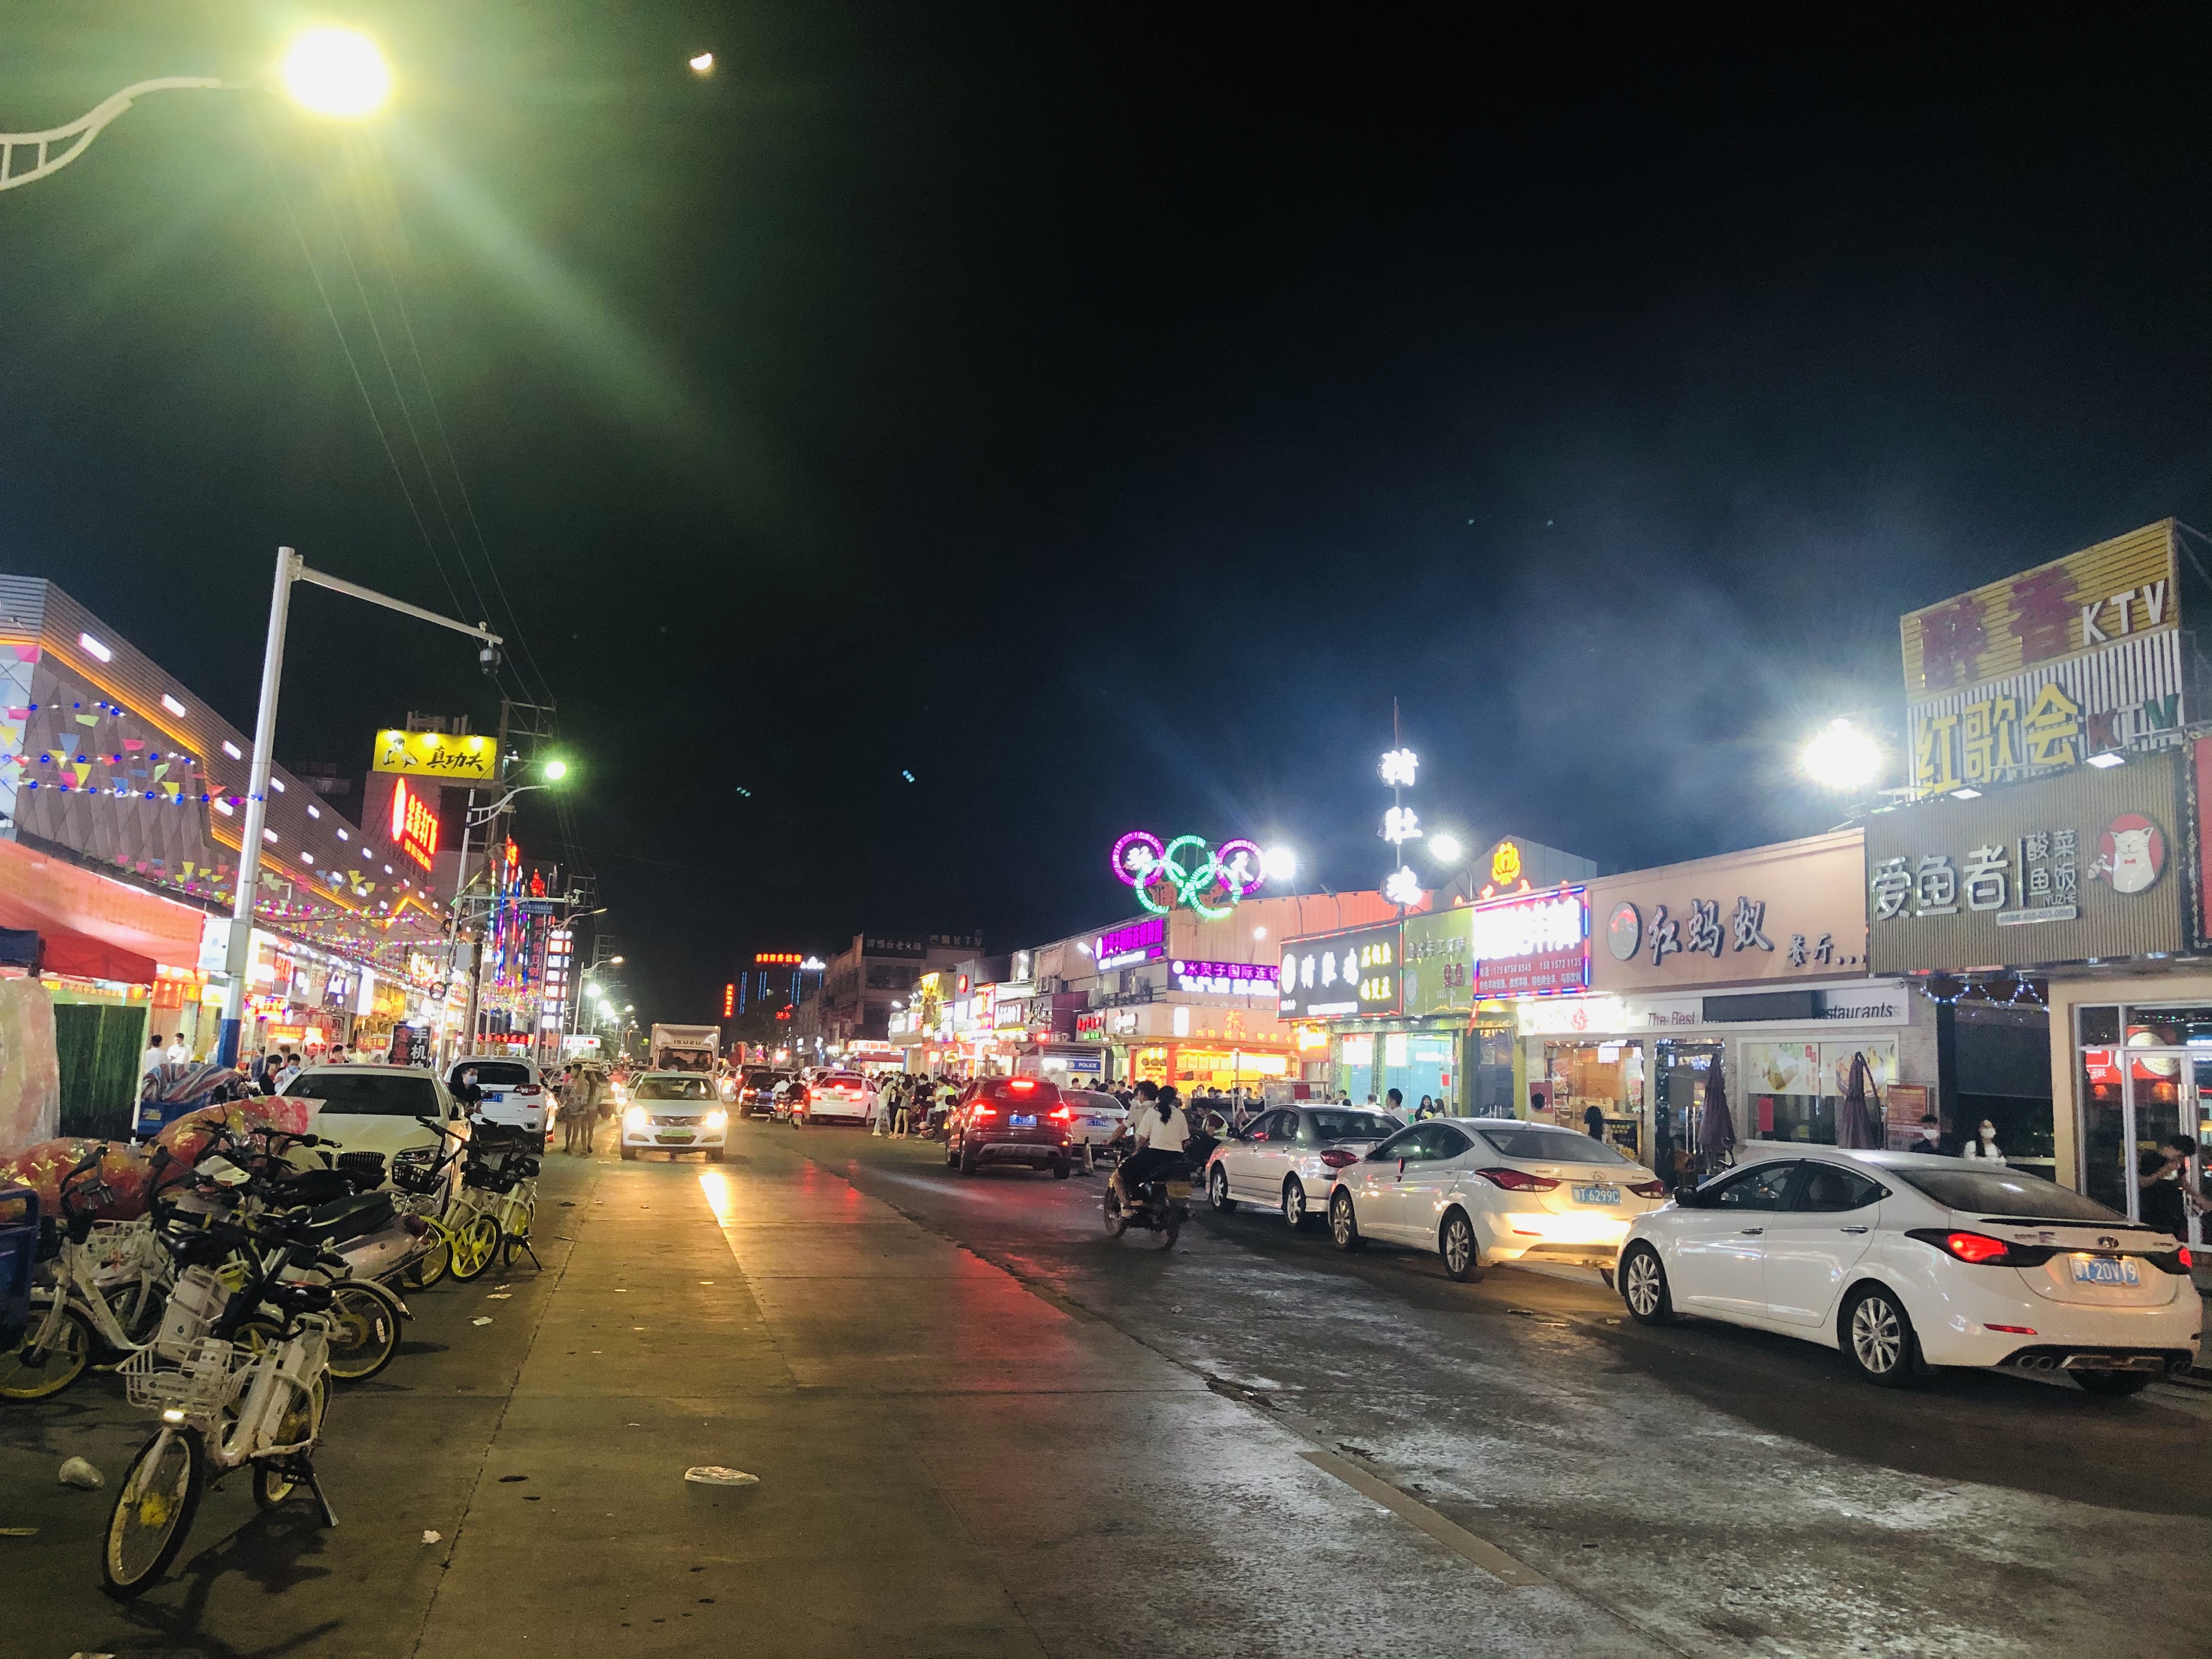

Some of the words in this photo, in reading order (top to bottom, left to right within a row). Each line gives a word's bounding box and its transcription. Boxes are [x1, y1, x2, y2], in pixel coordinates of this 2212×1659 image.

[2081, 579, 2170, 646] KTV
[426, 746, 484, 772] 真功夫
[1915, 682, 2079, 798] 红歌会
[2087, 693, 2180, 750] KTV
[1872, 844, 2008, 921] 爱鱼者
[1647, 896, 1775, 966] 红蚂蚁
[1671, 1011, 1695, 1025] Best
